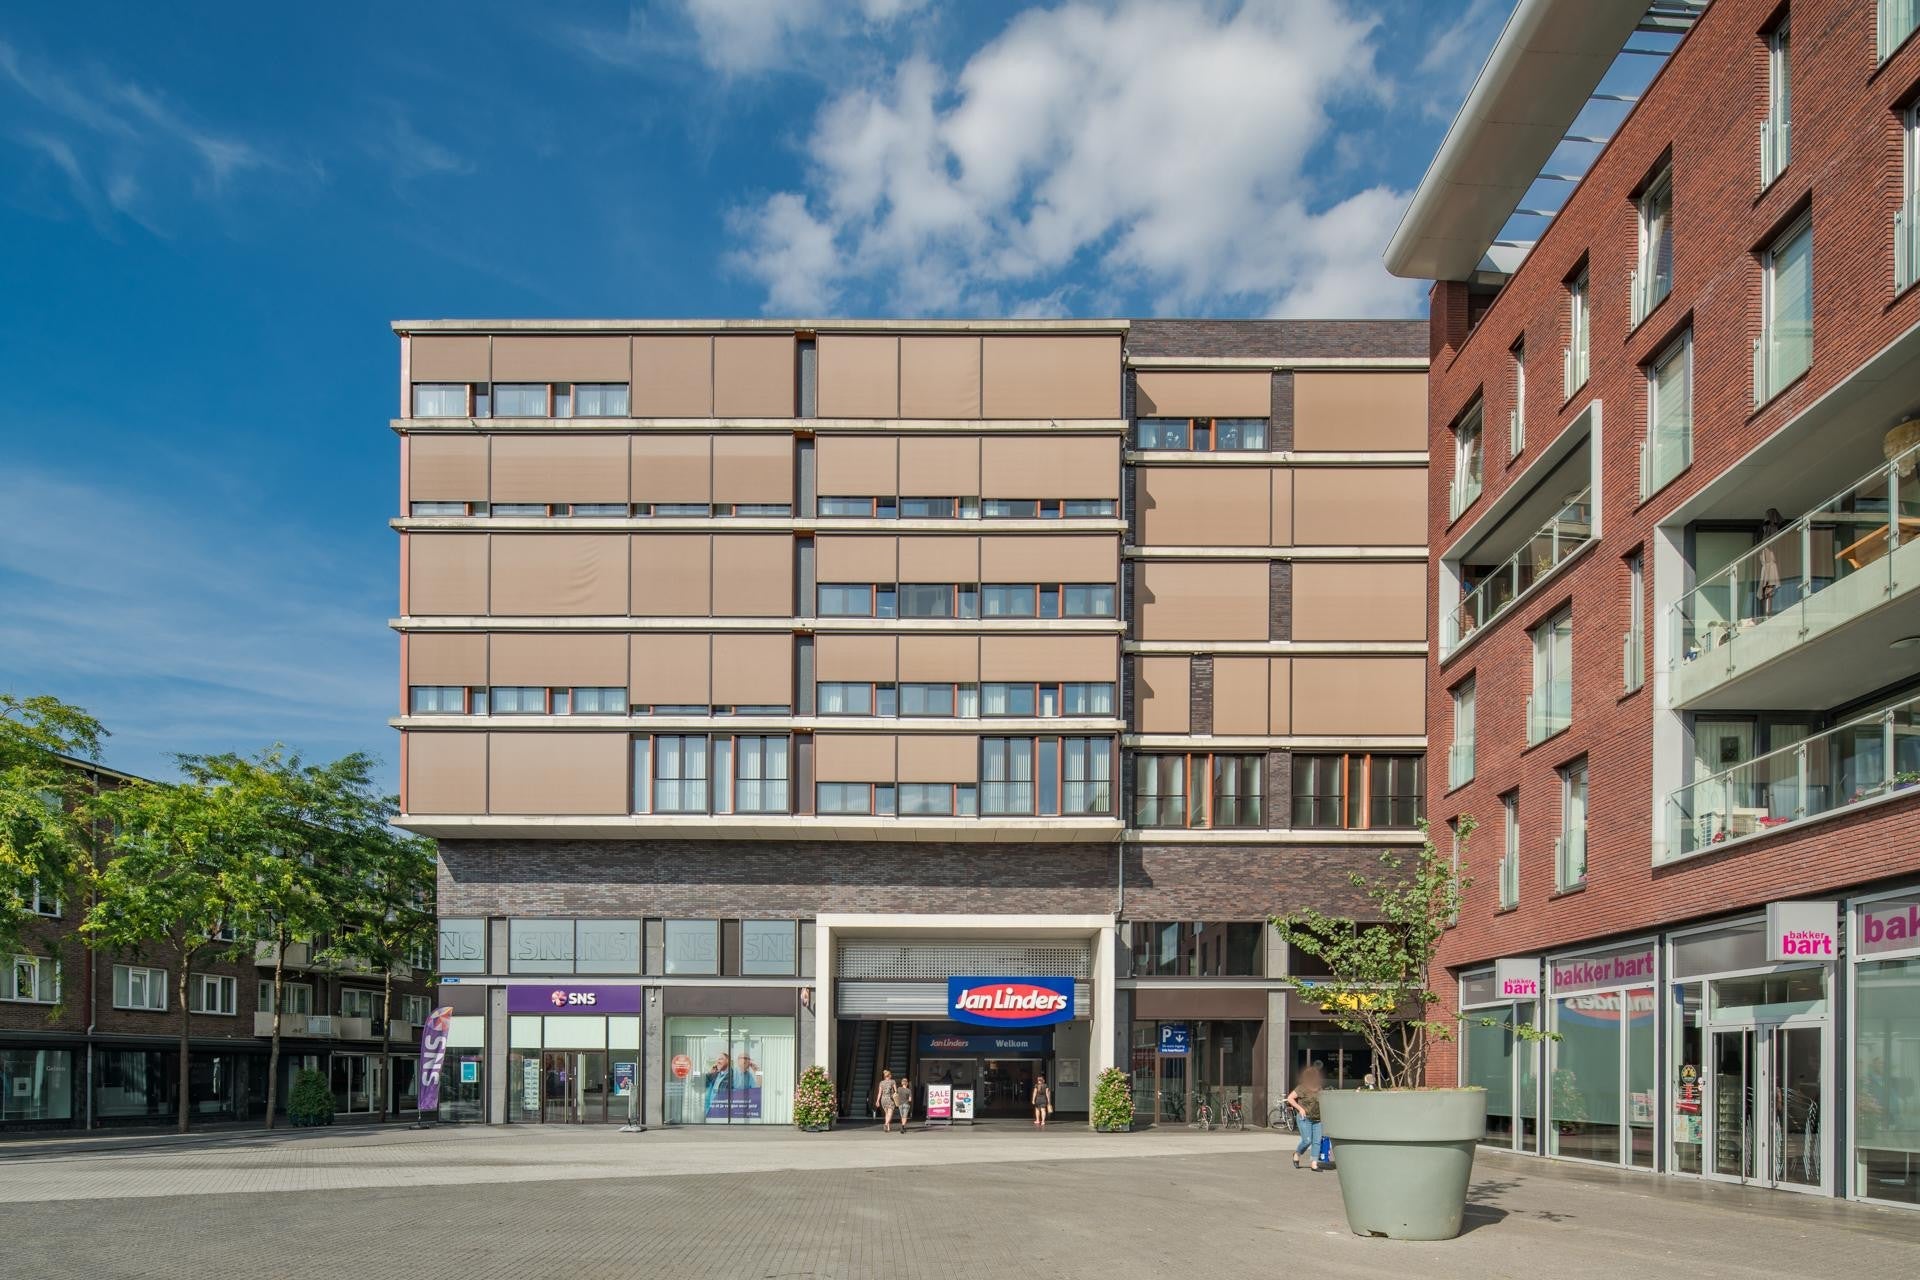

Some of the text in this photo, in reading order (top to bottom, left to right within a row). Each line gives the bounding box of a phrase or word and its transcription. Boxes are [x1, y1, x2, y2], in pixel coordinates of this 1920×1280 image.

[1790, 931, 1825, 939] bakker
[1783, 936, 1832, 954] bart
[1554, 951, 1654, 987] bakker bart
[1504, 981, 1537, 994] bart
[568, 992, 596, 1005] SNS
[955, 987, 1068, 1010] Jan Linders
[1162, 1029, 1172, 1042] P
[930, 1038, 969, 1047] Jan Linders
[995, 1039, 1029, 1048] Welkom
[422, 1035, 447, 1087] SNS
[930, 1091, 950, 1099] SALE
